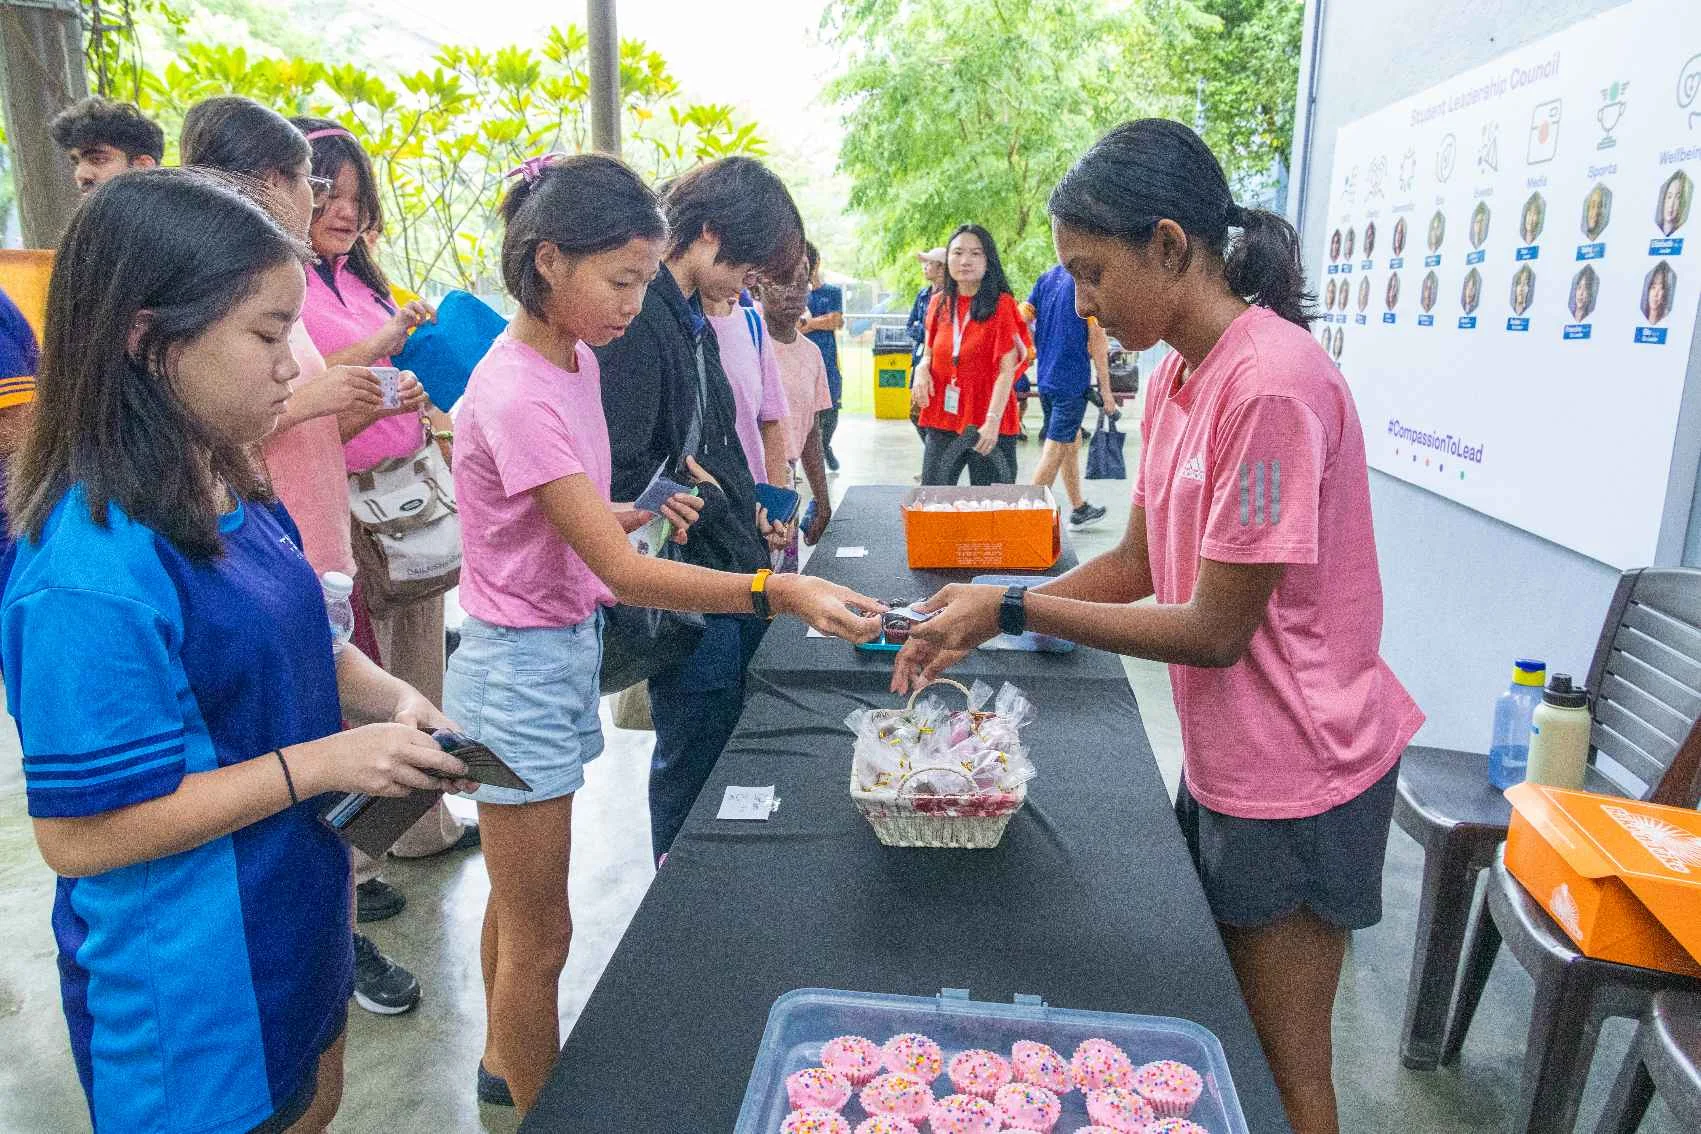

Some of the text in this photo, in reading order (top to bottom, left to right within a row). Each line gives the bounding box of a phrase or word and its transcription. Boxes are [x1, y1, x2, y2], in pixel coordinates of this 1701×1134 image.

[1409, 50, 1561, 128] Student Leadership Council
[1387, 418, 1484, 464] #CompassionToLead
